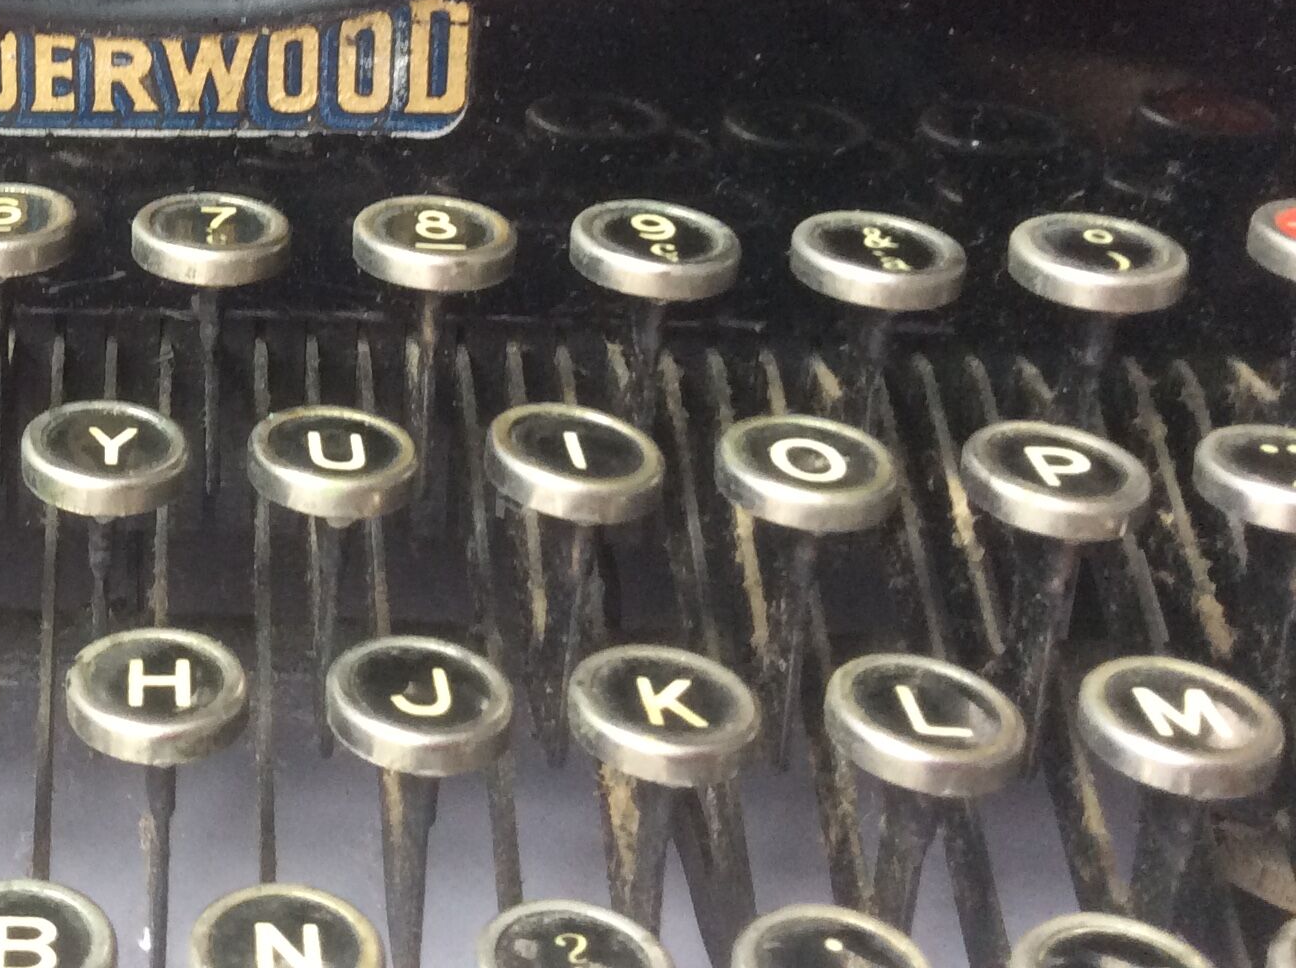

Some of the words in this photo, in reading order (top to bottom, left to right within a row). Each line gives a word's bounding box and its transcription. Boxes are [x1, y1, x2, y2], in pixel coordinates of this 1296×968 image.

[201, 206, 236, 229] 7
[416, 210, 457, 239] 8
[631, 214, 675, 240] 9
[89, 427, 137, 465] Y
[308, 431, 365, 470] U
[563, 431, 586, 469] I
[770, 438, 847, 482] O
[1024, 446, 1091, 487] P
[128, 659, 196, 710] H
[391, 668, 451, 716] J
[637, 677, 708, 727] K
[895, 685, 973, 737] L
[1132, 687, 1233, 737] M
